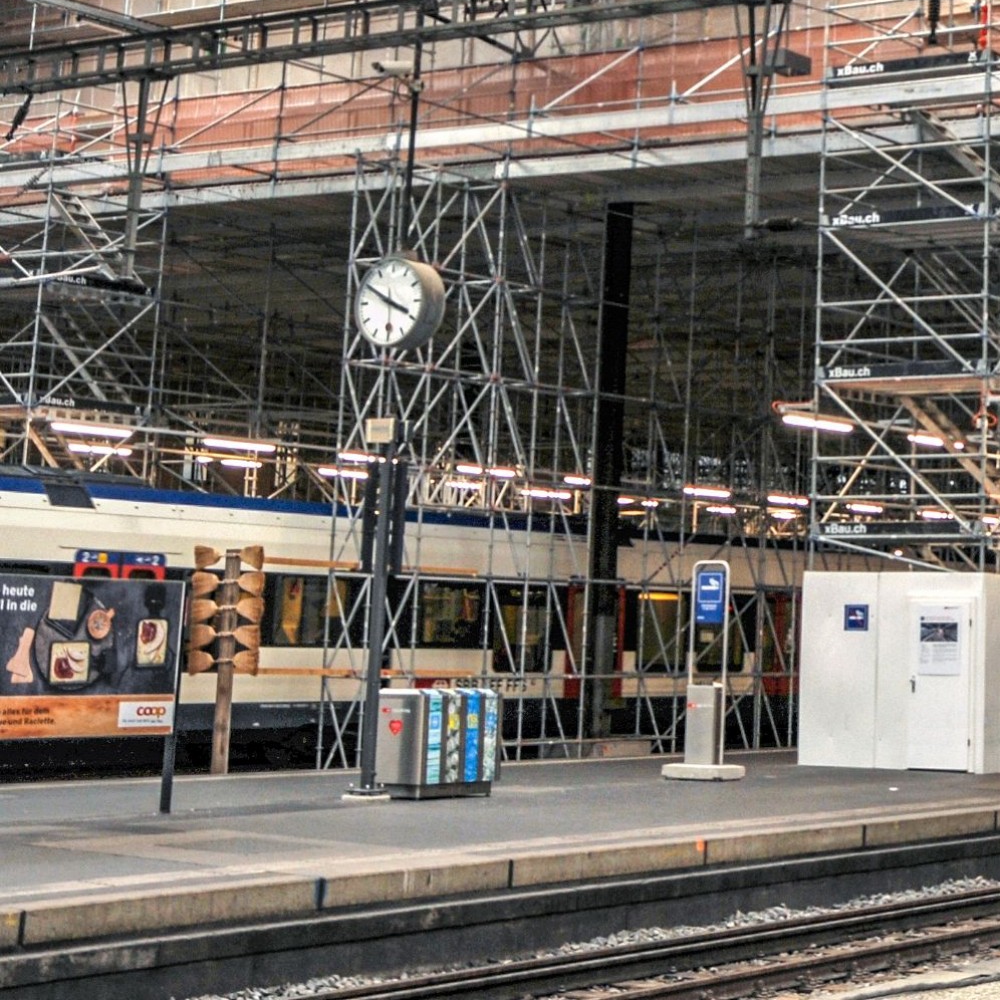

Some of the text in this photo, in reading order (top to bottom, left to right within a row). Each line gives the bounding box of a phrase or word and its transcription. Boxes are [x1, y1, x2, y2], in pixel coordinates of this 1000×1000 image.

[837, 62, 884, 76] xBau.ch
[831, 211, 880, 227] xBau.ch
[829, 367, 871, 378] xBau.ch
[824, 522, 867, 534] xBau.ch
[81, 551, 90, 563] 2
[152, 555, 160, 566] 2
[2, 583, 35, 597] heute
[7, 599, 18, 611] in
[20, 599, 38, 612] die
[136, 706, 167, 719] coop
